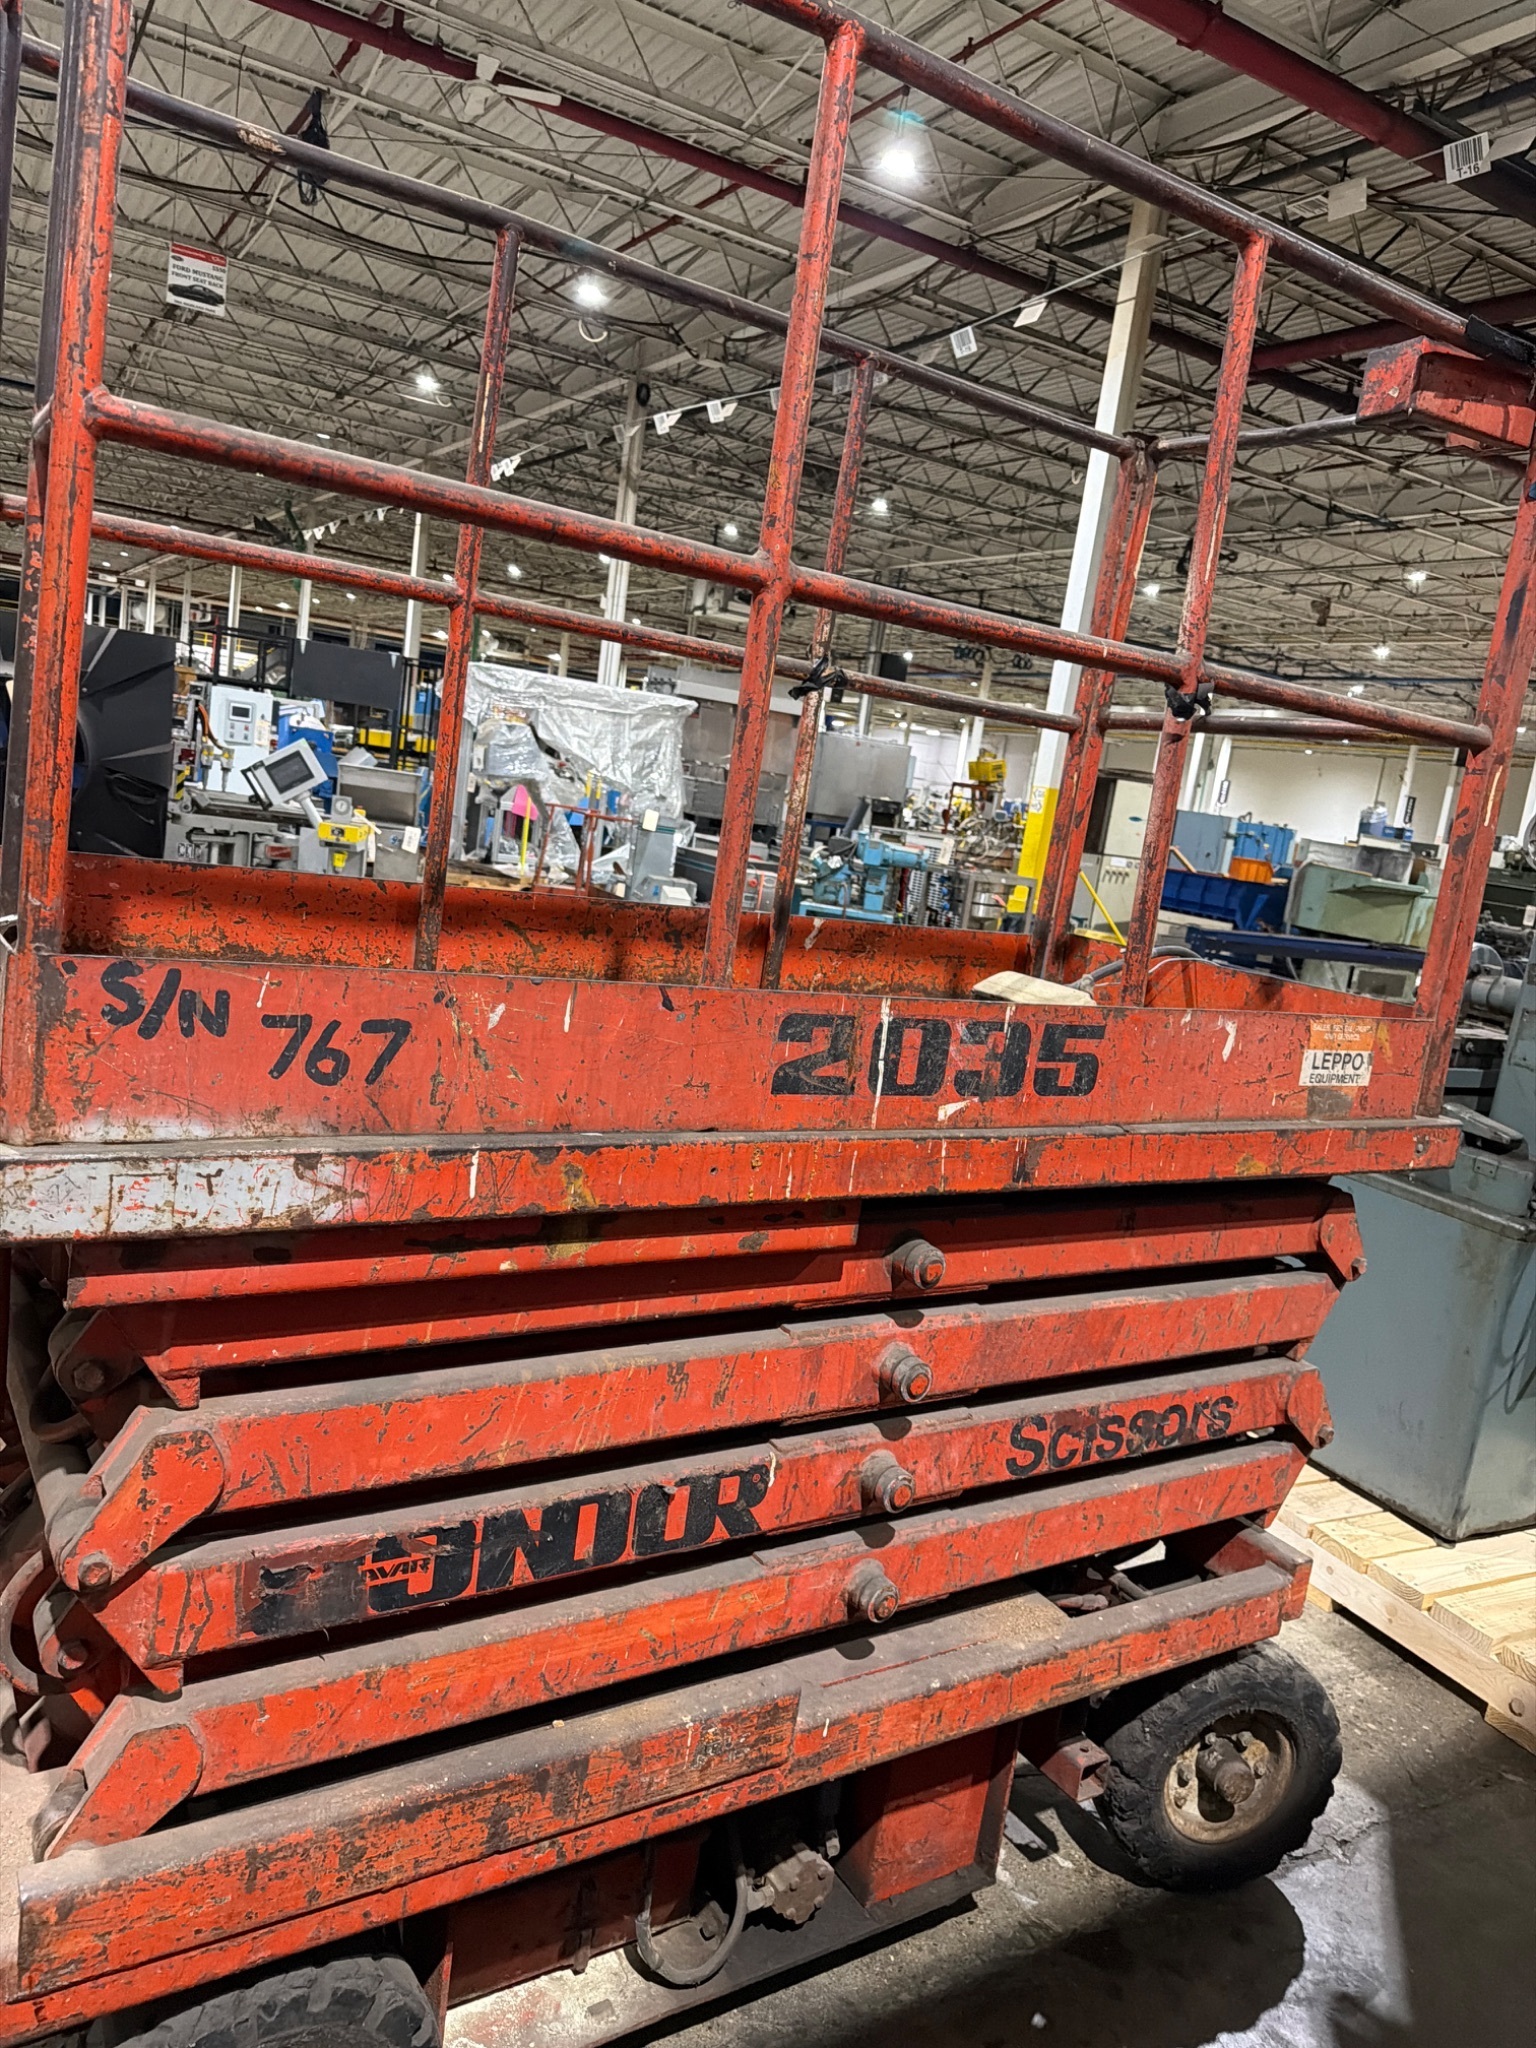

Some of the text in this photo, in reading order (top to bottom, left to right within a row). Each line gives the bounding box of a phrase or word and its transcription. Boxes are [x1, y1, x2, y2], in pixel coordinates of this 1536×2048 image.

[1456, 163, 1480, 178] T-16
[172, 263, 224, 282] FORD MUSTANG
[172, 271, 191, 280] FRONT
[101, 960, 230, 1040] S/N
[261, 1013, 413, 1086] 767
[770, 1012, 1107, 1099] 2035
[1311, 1052, 1364, 1071] LEPPO
[1309, 1073, 1361, 1084] EQUIPMENT
